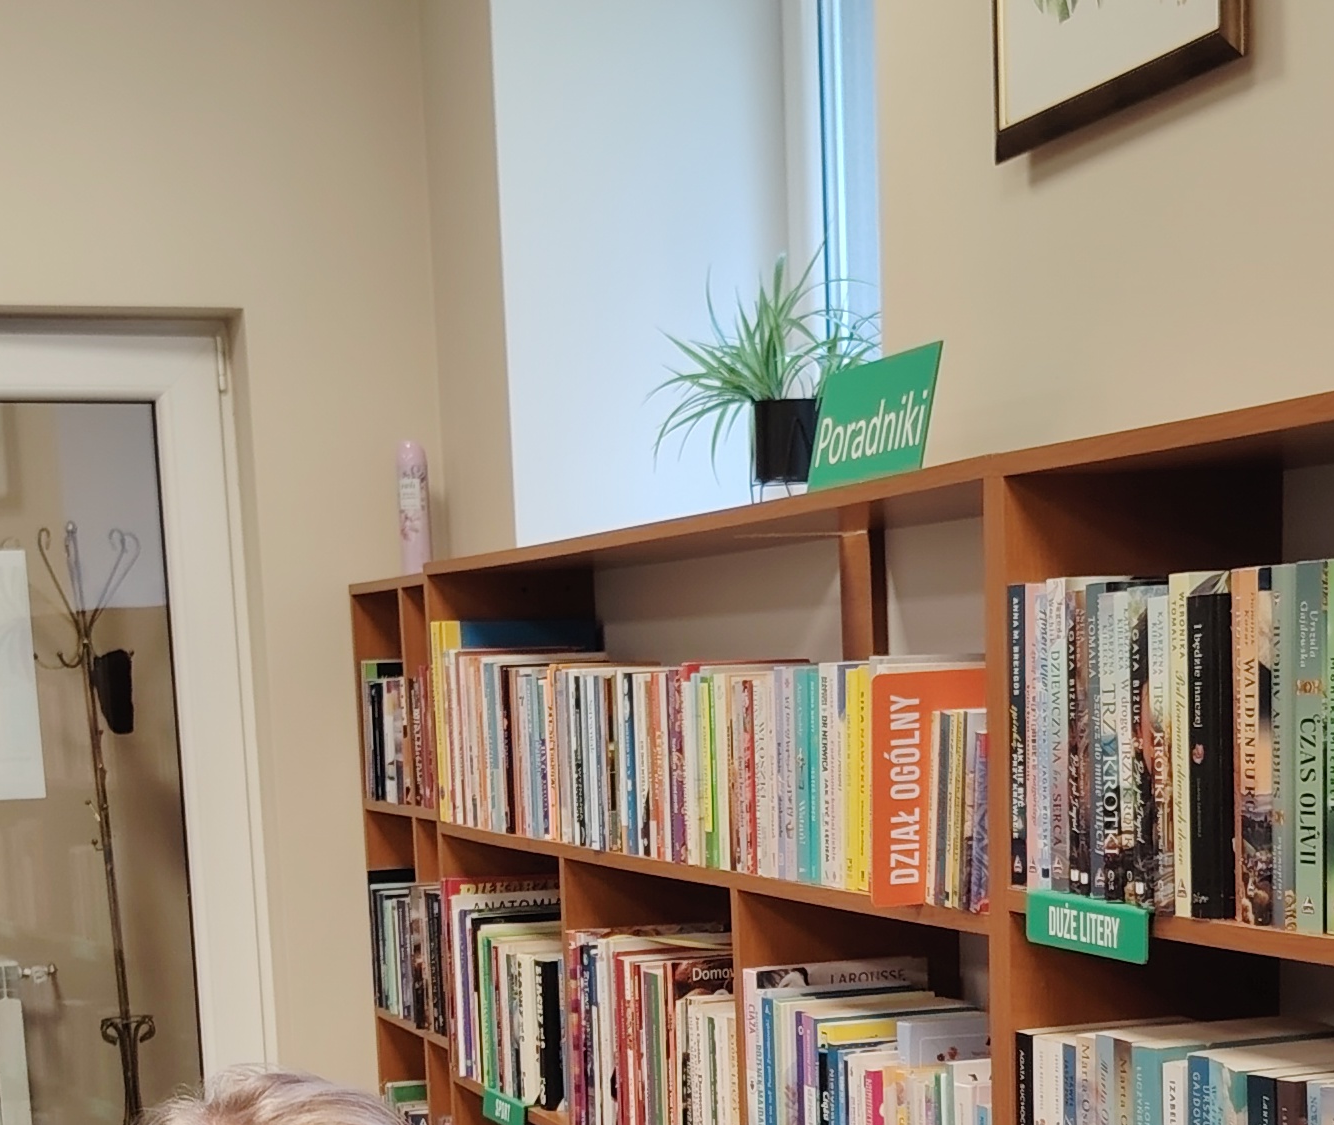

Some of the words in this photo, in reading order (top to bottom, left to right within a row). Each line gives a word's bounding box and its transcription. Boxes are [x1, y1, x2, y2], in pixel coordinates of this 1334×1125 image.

[815, 389, 928, 468] Poradniki
[1088, 616, 1097, 678] TOMALA
[1192, 632, 1203, 678] będzie
[1051, 651, 1063, 764] DZIEWCZYNA
[1133, 680, 1141, 724] BIZUK
[1192, 681, 1203, 728] inaczej
[890, 694, 919, 799] OGÓLNY
[1299, 715, 1321, 782] CZAS
[1052, 793, 1063, 846] SERCA
[1094, 800, 1105, 856] WIĘCEJ
[890, 808, 919, 885] DZIAŁ
[1048, 903, 1077, 940] DUŻE
[1079, 912, 1120, 948] LITERY
[1081, 1044, 1090, 1095] Marta
[1119, 1058, 1127, 1108] Marta
[495, 1099, 511, 1123] SPORT
